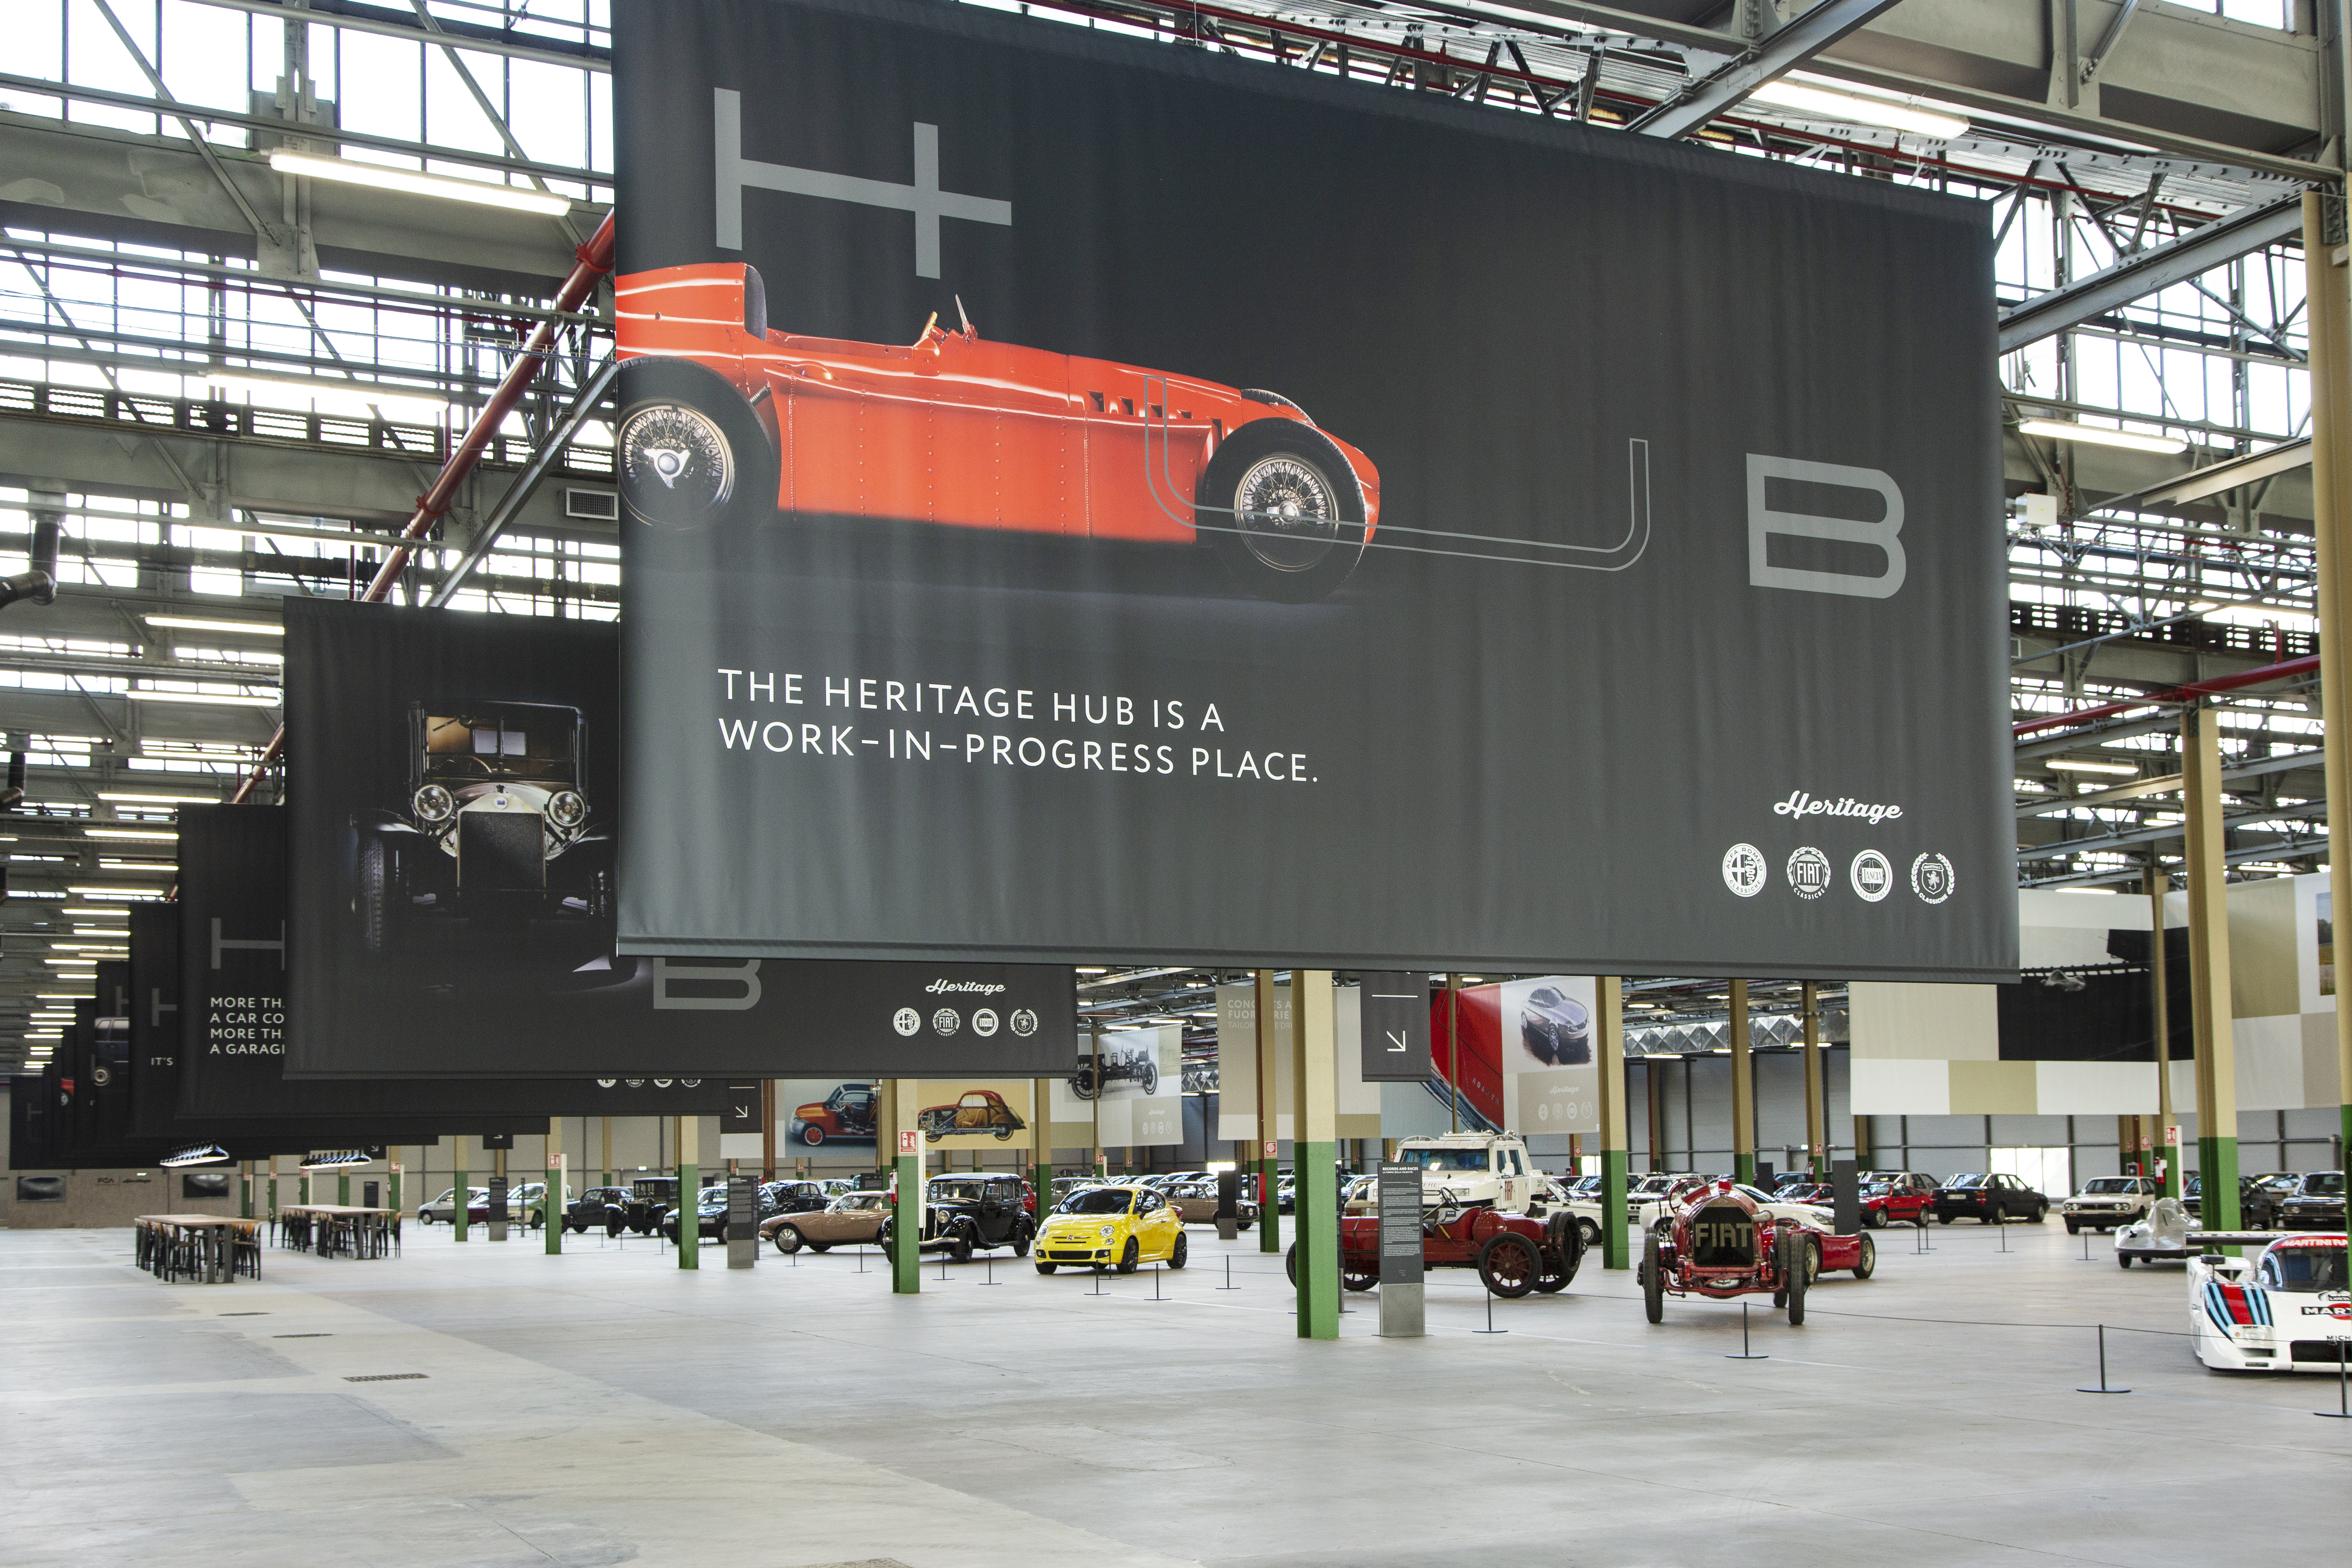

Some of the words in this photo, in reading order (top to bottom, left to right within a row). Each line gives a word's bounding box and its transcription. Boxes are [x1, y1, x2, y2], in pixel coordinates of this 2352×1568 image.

[718, 669, 803, 704] THE
[825, 677, 1034, 719] HERITAGE
[1054, 693, 1134, 725] HUB
[1154, 699, 1184, 729] IS
[1200, 703, 1224, 732] A
[718, 718, 1174, 774] WORK-IN-PROGRESS
[1192, 748, 1318, 782] PLACE.
[1774, 790, 1903, 825] Heritage
[1726, 849, 1738, 869] ALFA
[1742, 847, 1763, 871] ROMEO
[1797, 862, 1821, 884] FIAT
[1729, 880, 1761, 893] CLASSICHE
[1793, 887, 1825, 900] CLASSICHE
[1860, 890, 1886, 900] CLASSICHE
[1919, 892, 1948, 904] CLASSICHE
[925, 978, 1006, 996] Heritage
[211, 997, 256, 1008] MORE
[261, 998, 285, 1008] TH
[209, 1013, 221, 1023] A
[226, 1013, 257, 1023] CAR
[905, 1010, 918, 1022] ROMEO
[939, 1017, 954, 1028] FIAT
[211, 1028, 256, 1039] MORE
[261, 1029, 285, 1039] TH
[209, 1044, 221, 1054] A
[1549, 1085, 1580, 1095] Heritage
[1695, 1223, 1753, 1247] FIAT
